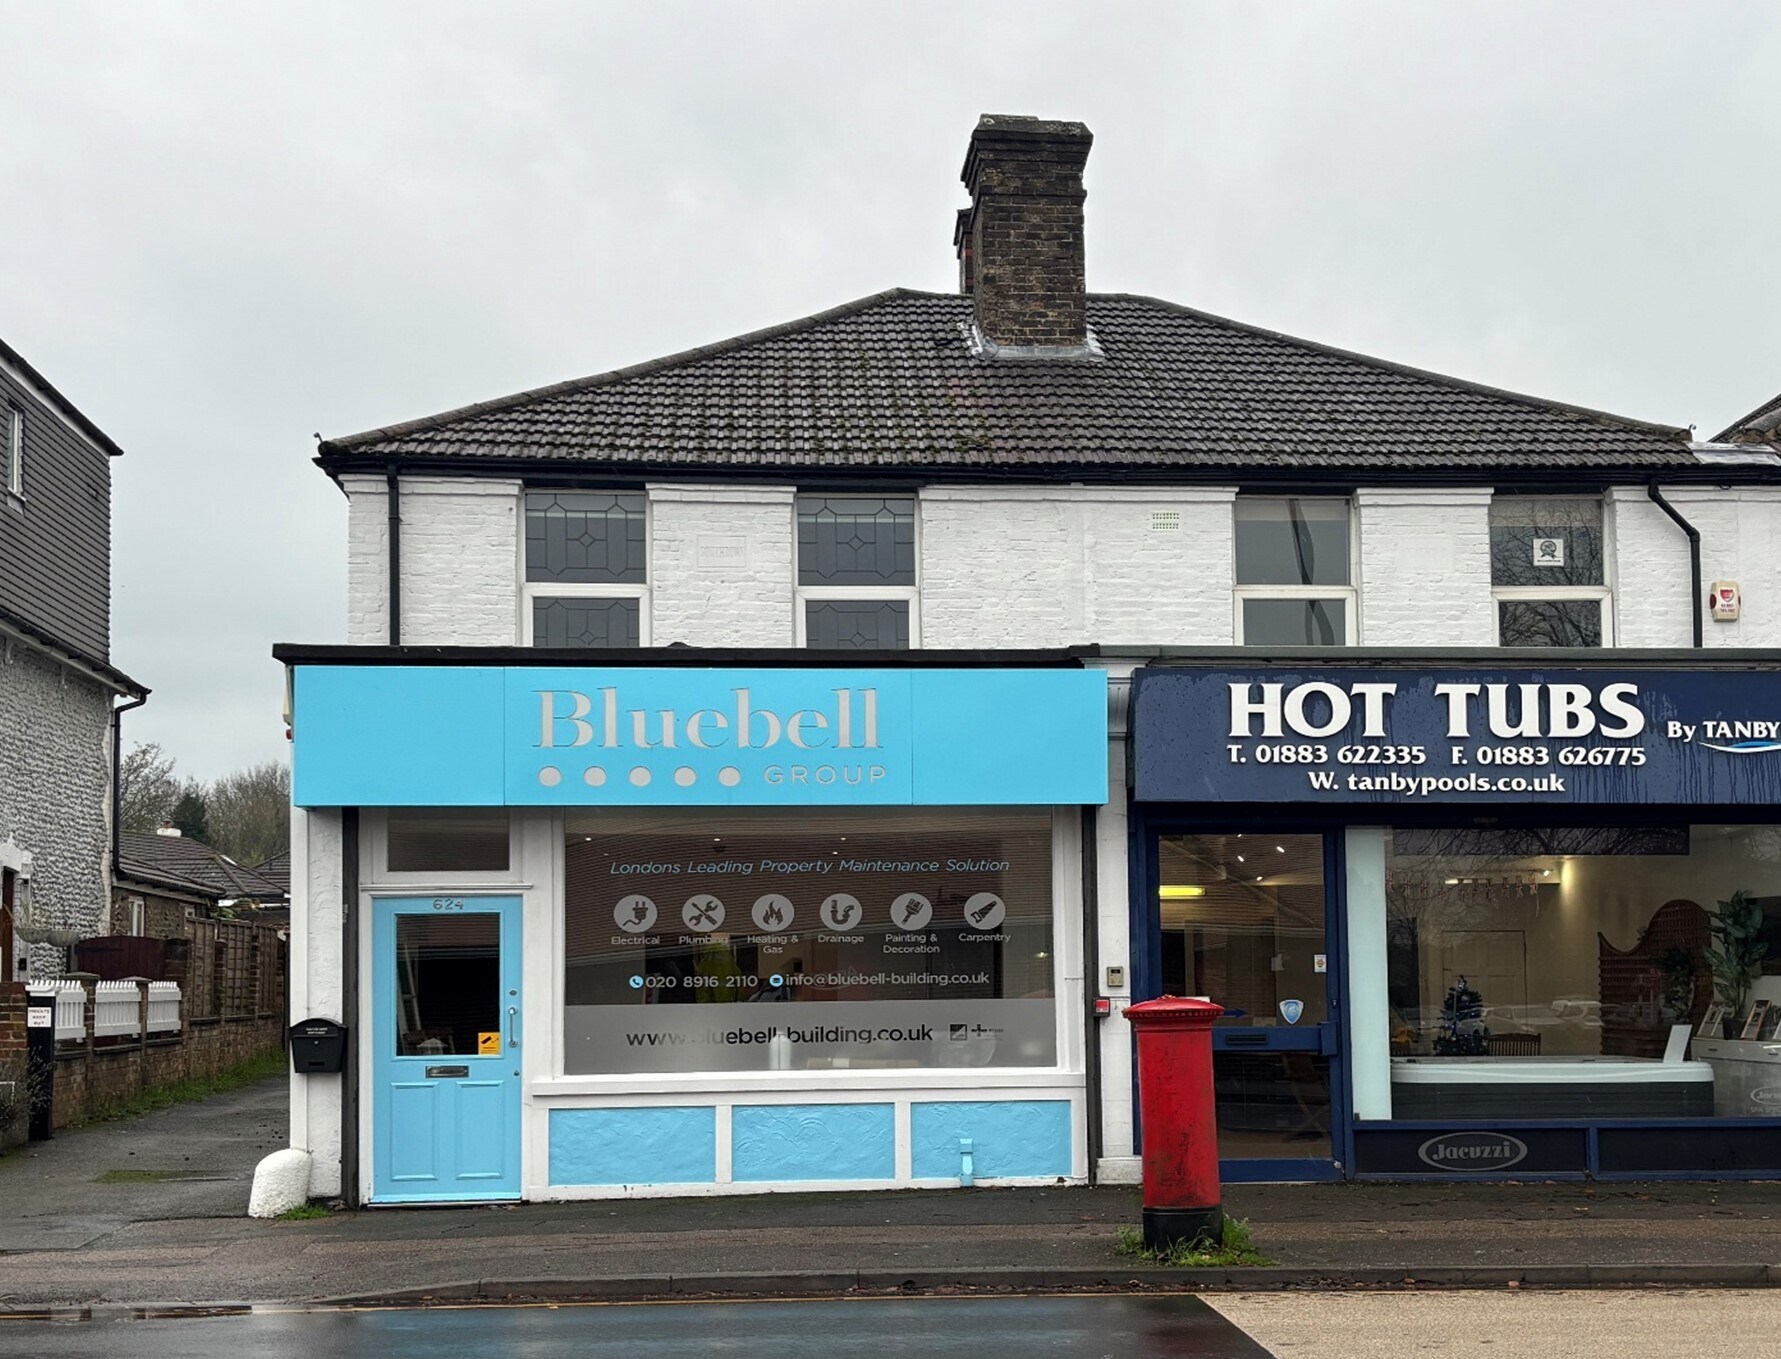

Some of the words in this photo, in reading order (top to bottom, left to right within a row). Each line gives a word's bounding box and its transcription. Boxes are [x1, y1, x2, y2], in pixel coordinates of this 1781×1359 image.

[532, 686, 884, 750] Bluebell
[1228, 682, 1397, 738] HOT
[1434, 682, 1645, 739] TUBS
[1667, 720, 1697, 743] By
[1702, 720, 1781, 739] TANBY
[1226, 744, 1247, 764] T.
[1255, 744, 1329, 764] 01883
[1337, 745, 1427, 765] 622335
[1451, 745, 1468, 765] F.
[1476, 746, 1550, 766] 01883
[1558, 746, 1647, 766] 626775
[764, 764, 887, 784] GROUP
[1307, 771, 1340, 791] W.
[1347, 772, 1566, 796] tanbypools.co.uk
[610, 861, 681, 875] Londons
[687, 860, 754, 876] Leading
[760, 859, 834, 875] Property
[839, 858, 940, 872] Maintenance
[945, 858, 1010, 872] Solution
[432, 898, 464, 910] 624
[611, 935, 660, 946] Electrical
[678, 935, 730, 946] Plumbing
[747, 934, 788, 945] Heating
[790, 934, 799, 944] &
[818, 933, 865, 944] Drainage
[885, 933, 927, 944] Painting
[929, 933, 938, 943] &
[958, 932, 1011, 944] Carpentry
[763, 945, 783, 954] Gas
[883, 944, 941, 954] Decoration
[646, 975, 677, 989] 020
[683, 975, 720, 988] 8916
[725, 975, 759, 988] 2110
[785, 971, 991, 989] info@bluebell-building.co.uk
[626, 1023, 934, 1046] www.luebellbuilding.co.uk
[1432, 1140, 1511, 1160] Jacuzzi
